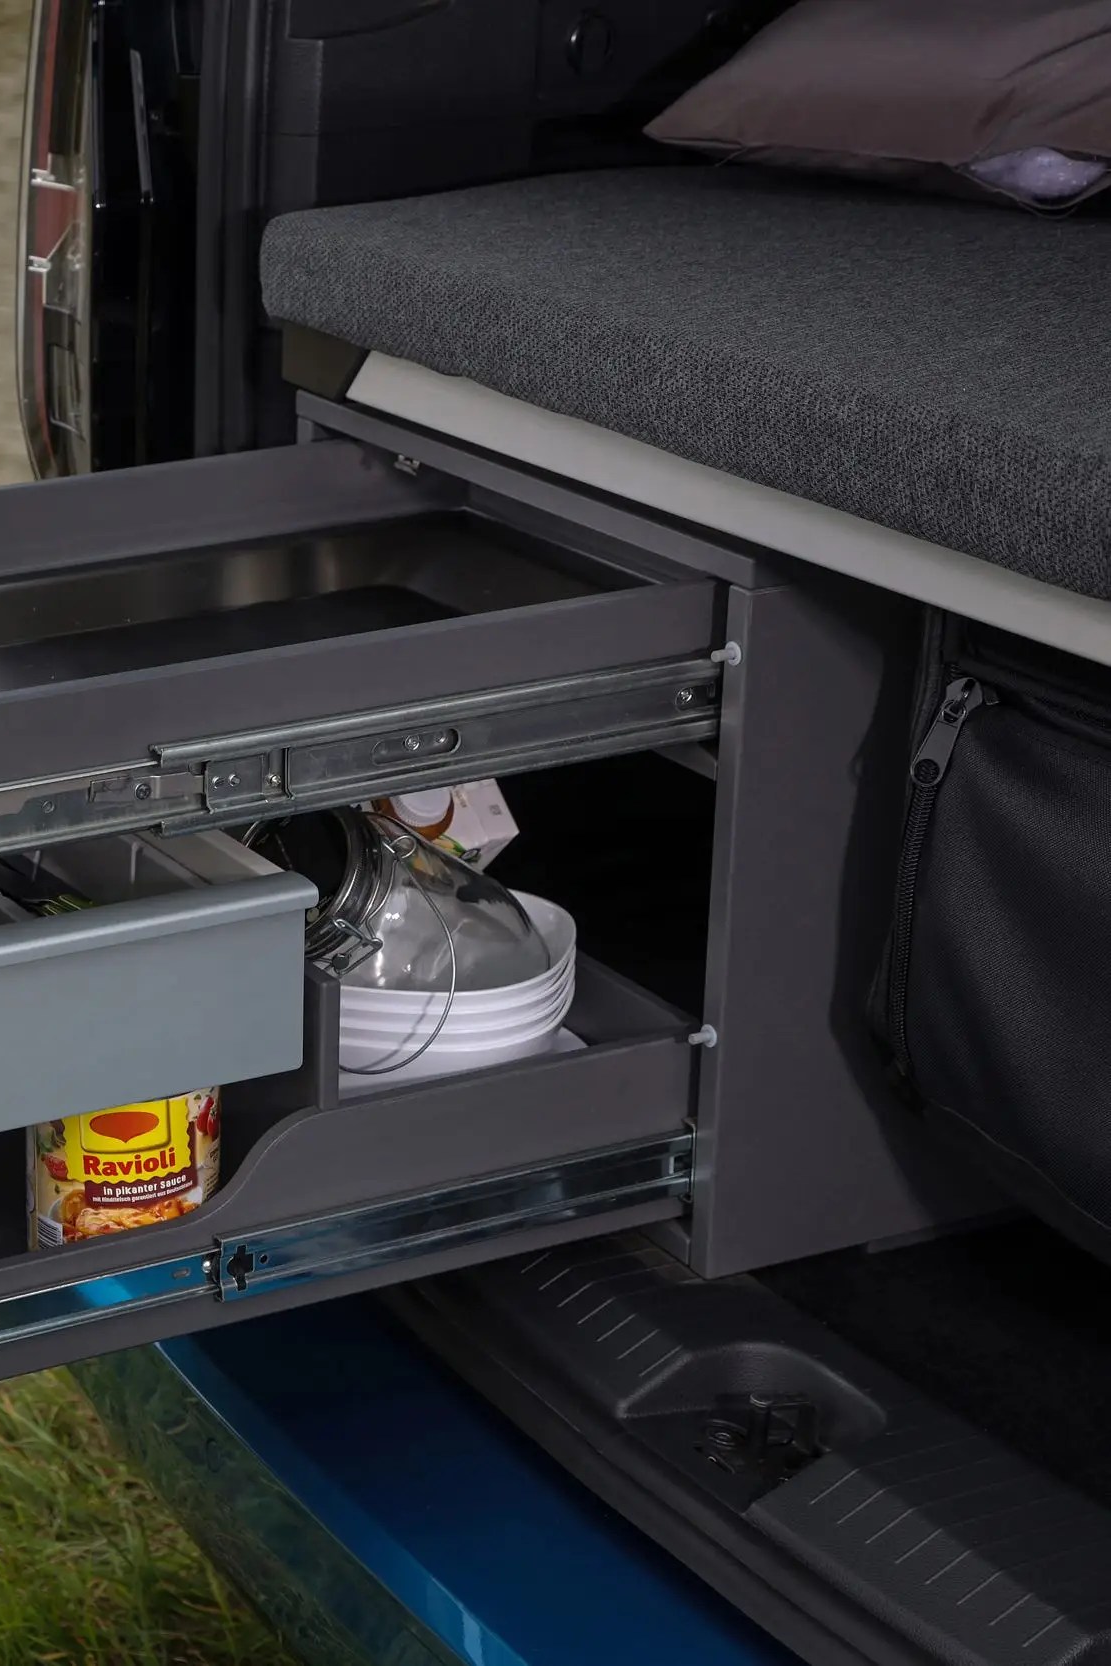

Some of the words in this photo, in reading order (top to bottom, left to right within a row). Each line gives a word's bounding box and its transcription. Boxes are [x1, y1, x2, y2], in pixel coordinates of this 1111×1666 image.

[83, 1147, 176, 1176] Ravioli
[103, 1186, 113, 1196] in
[116, 1183, 157, 1197] pikanter
[160, 1174, 187, 1189] Sauce
